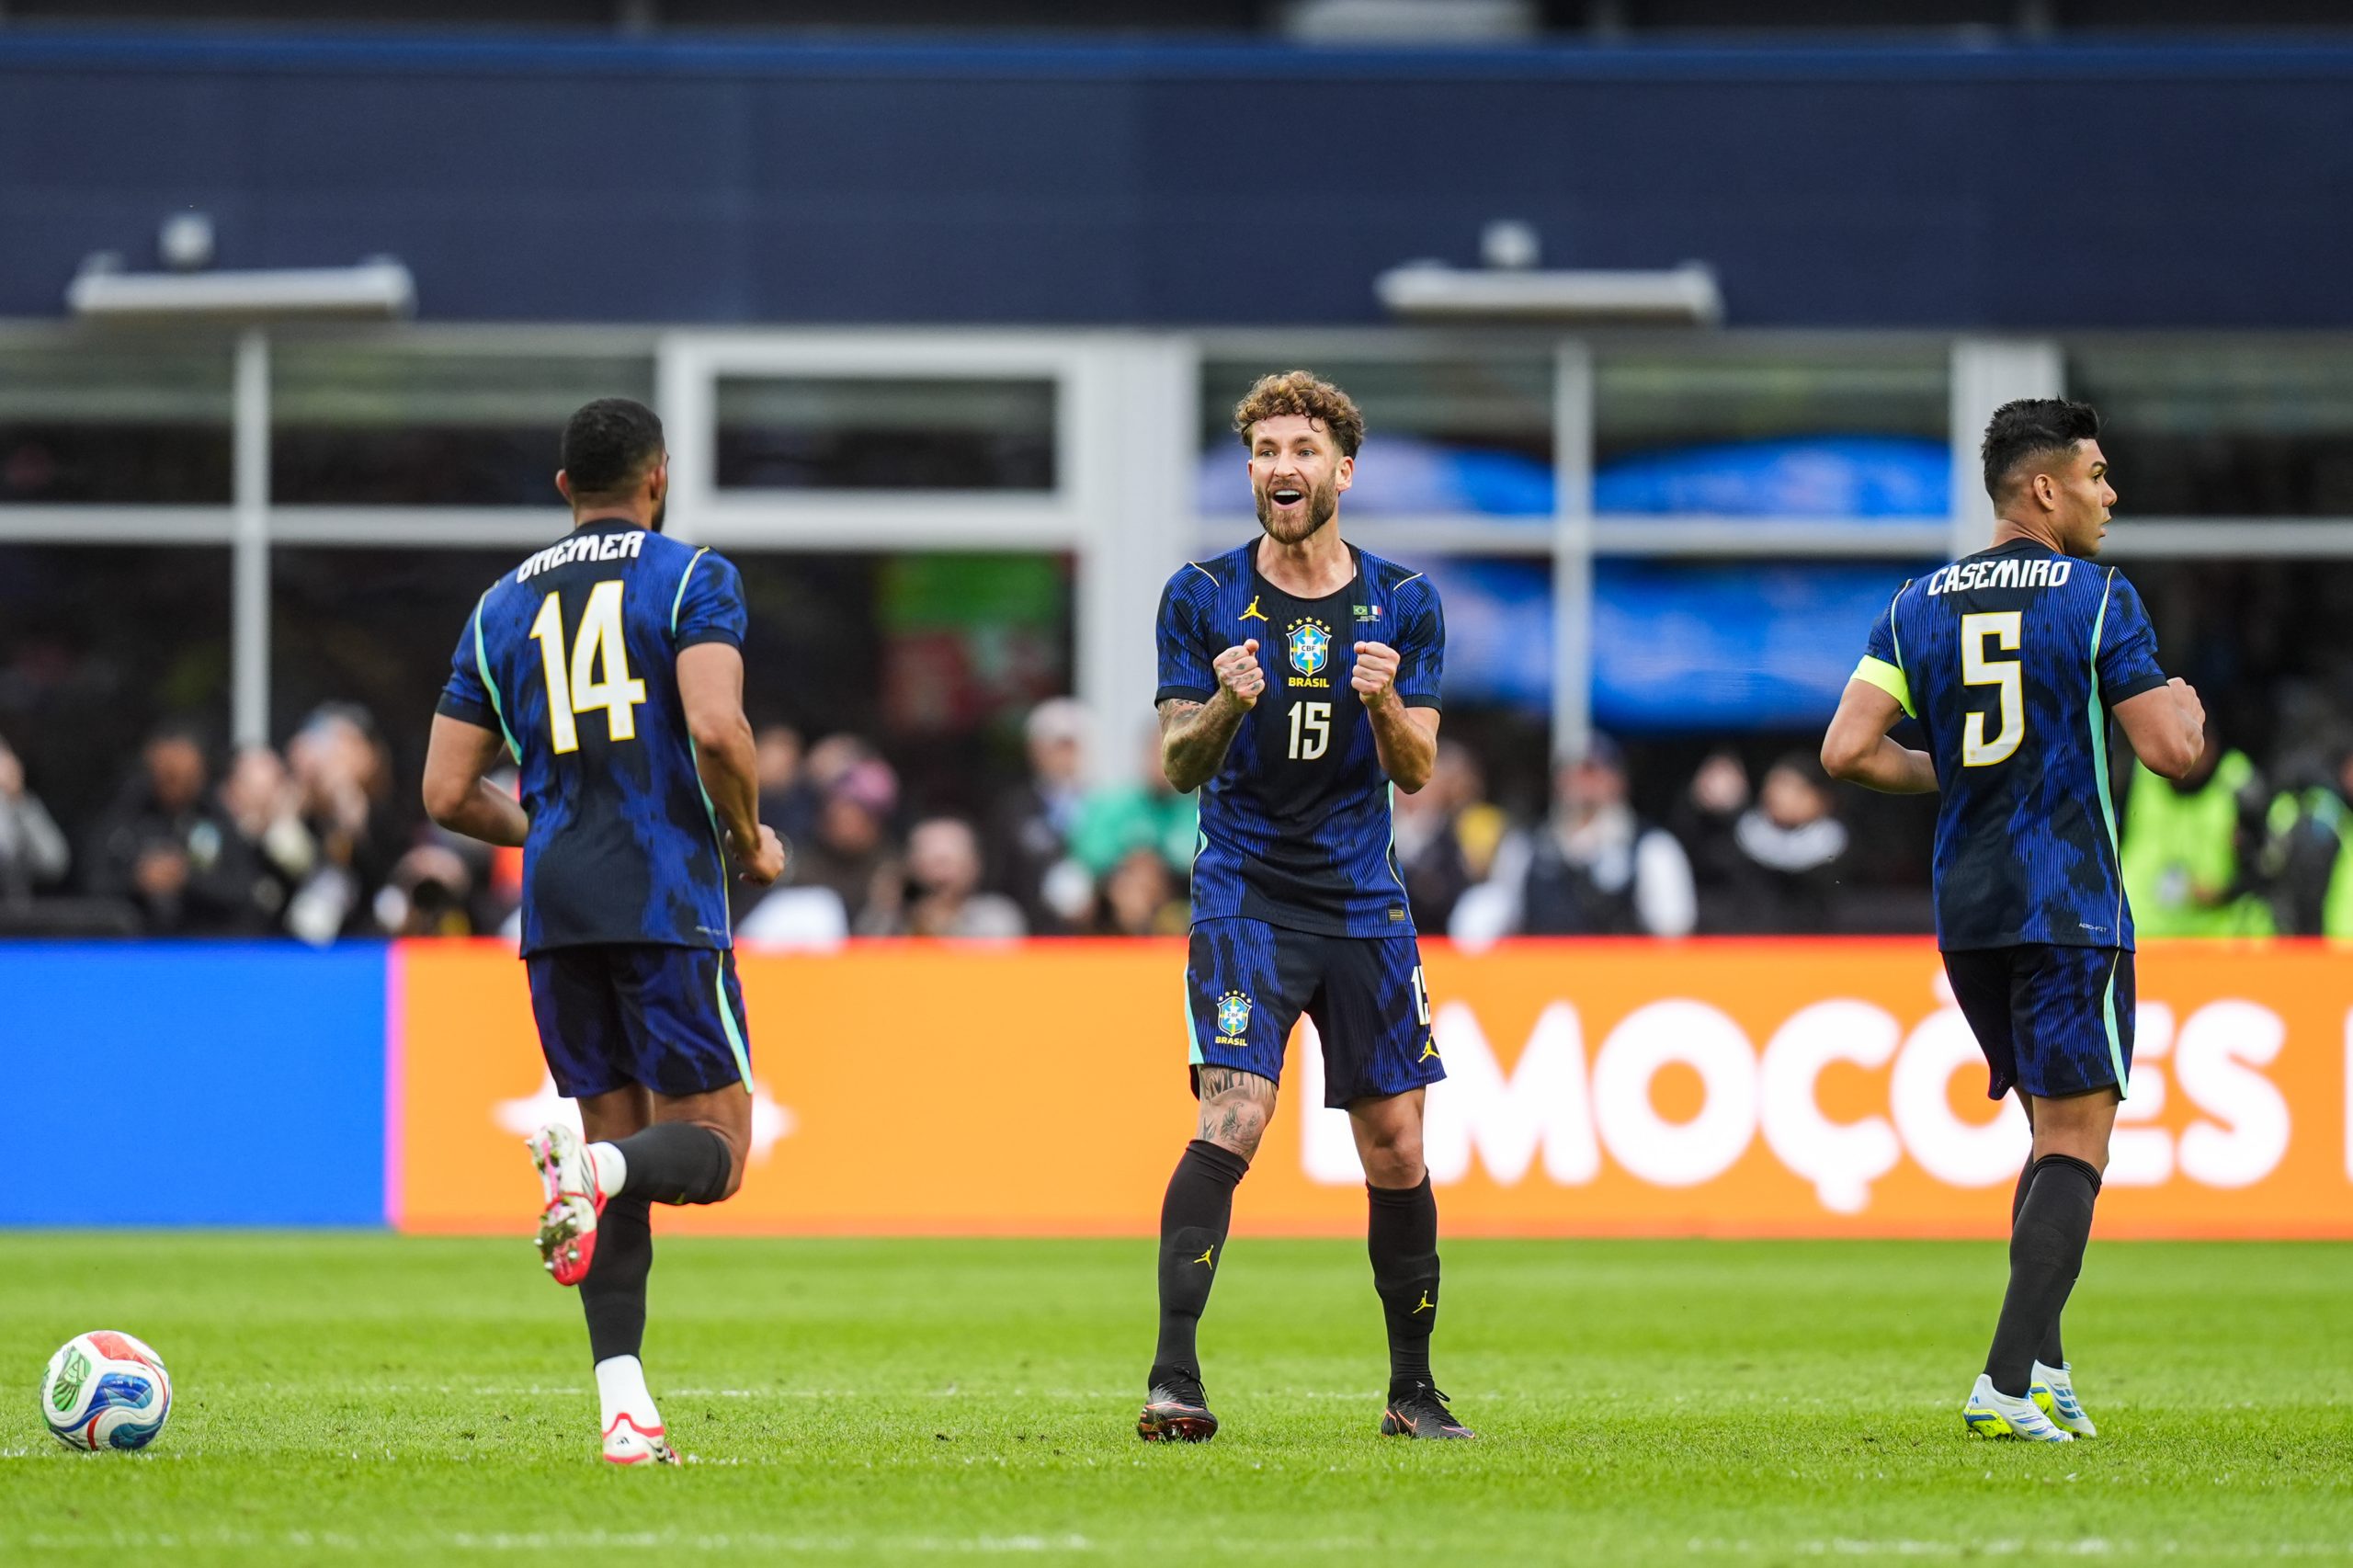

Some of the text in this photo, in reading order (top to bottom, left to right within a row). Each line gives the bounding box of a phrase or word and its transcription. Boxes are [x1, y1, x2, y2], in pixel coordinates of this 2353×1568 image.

[1927, 559, 2072, 596] CASEMIRO
[529, 580, 646, 755] 14
[1288, 676, 1330, 688] BRASIL
[1961, 611, 2025, 767] 5
[1288, 700, 1332, 760] 15
[1215, 1036, 1248, 1047] BRASIL
